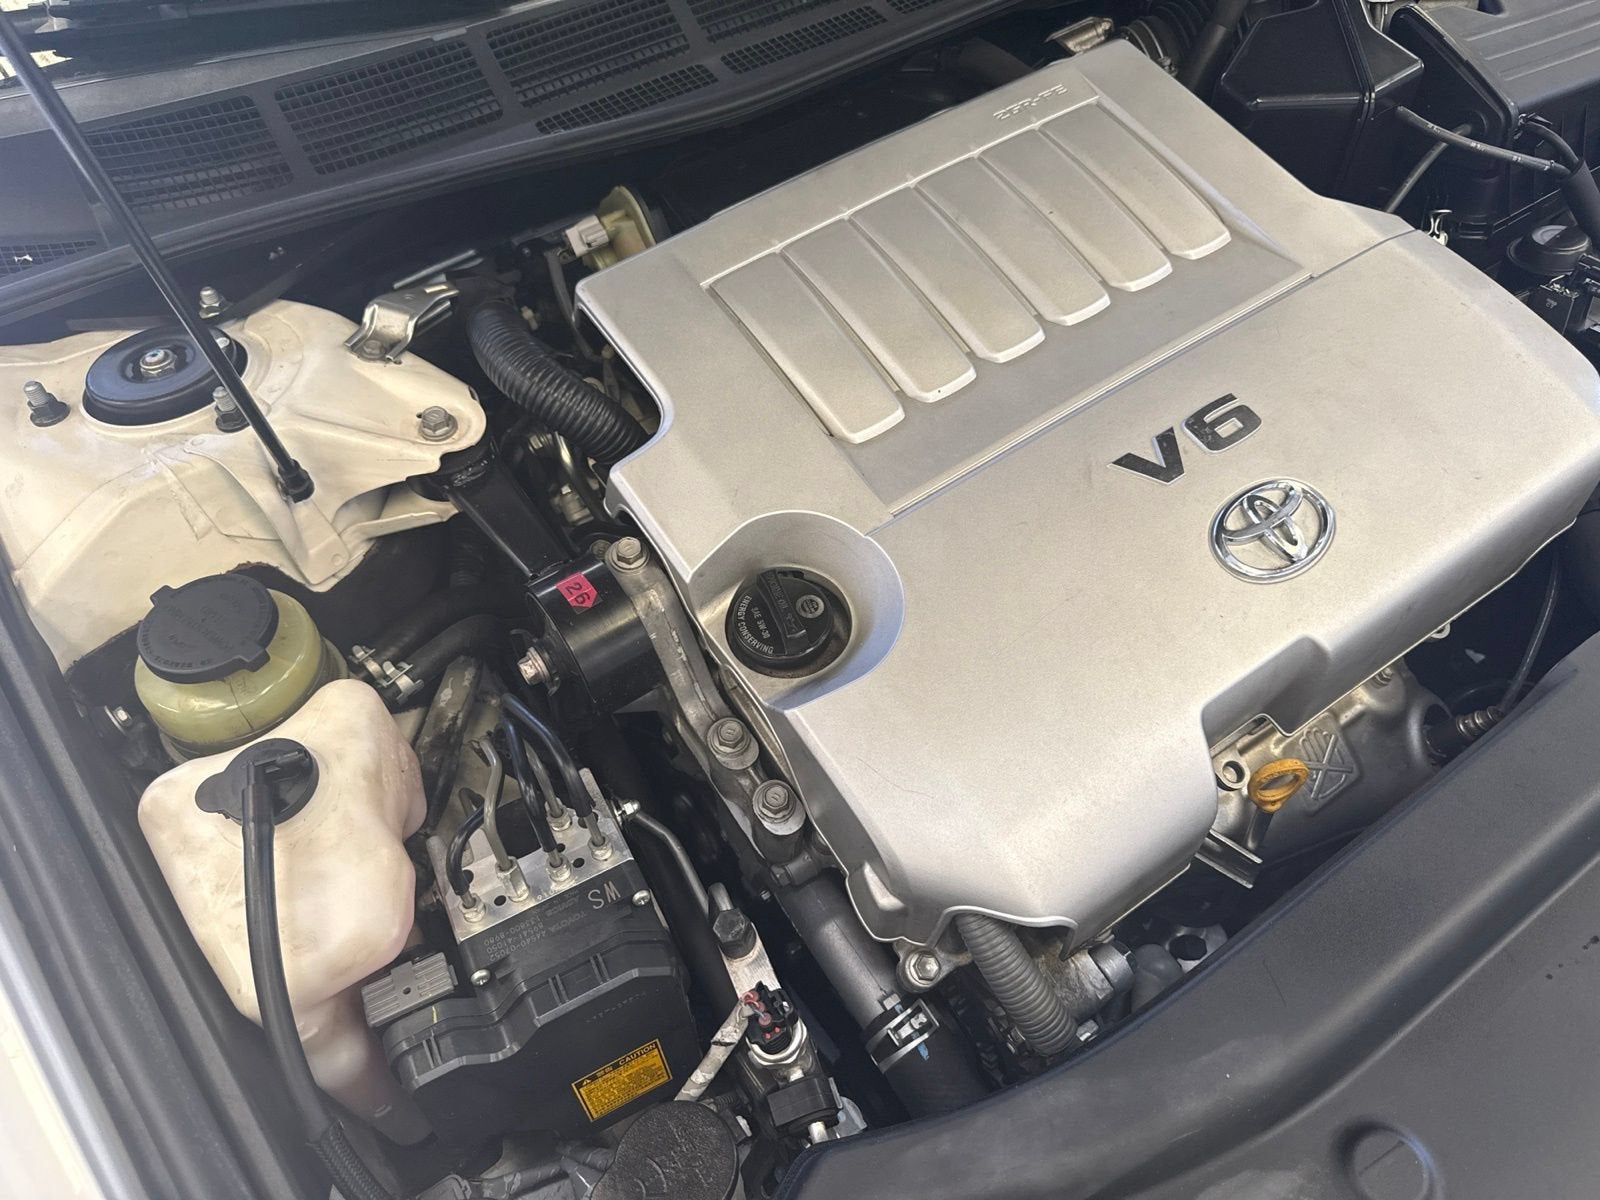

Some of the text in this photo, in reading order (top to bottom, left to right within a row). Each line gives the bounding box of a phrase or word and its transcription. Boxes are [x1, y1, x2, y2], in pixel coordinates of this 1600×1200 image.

[1107, 392, 1262, 484] V6
[737, 595, 774, 654] ENERGY CONSERVING
[549, 911, 587, 932] TOYOTA
[619, 1044, 656, 1065] CAUTION
